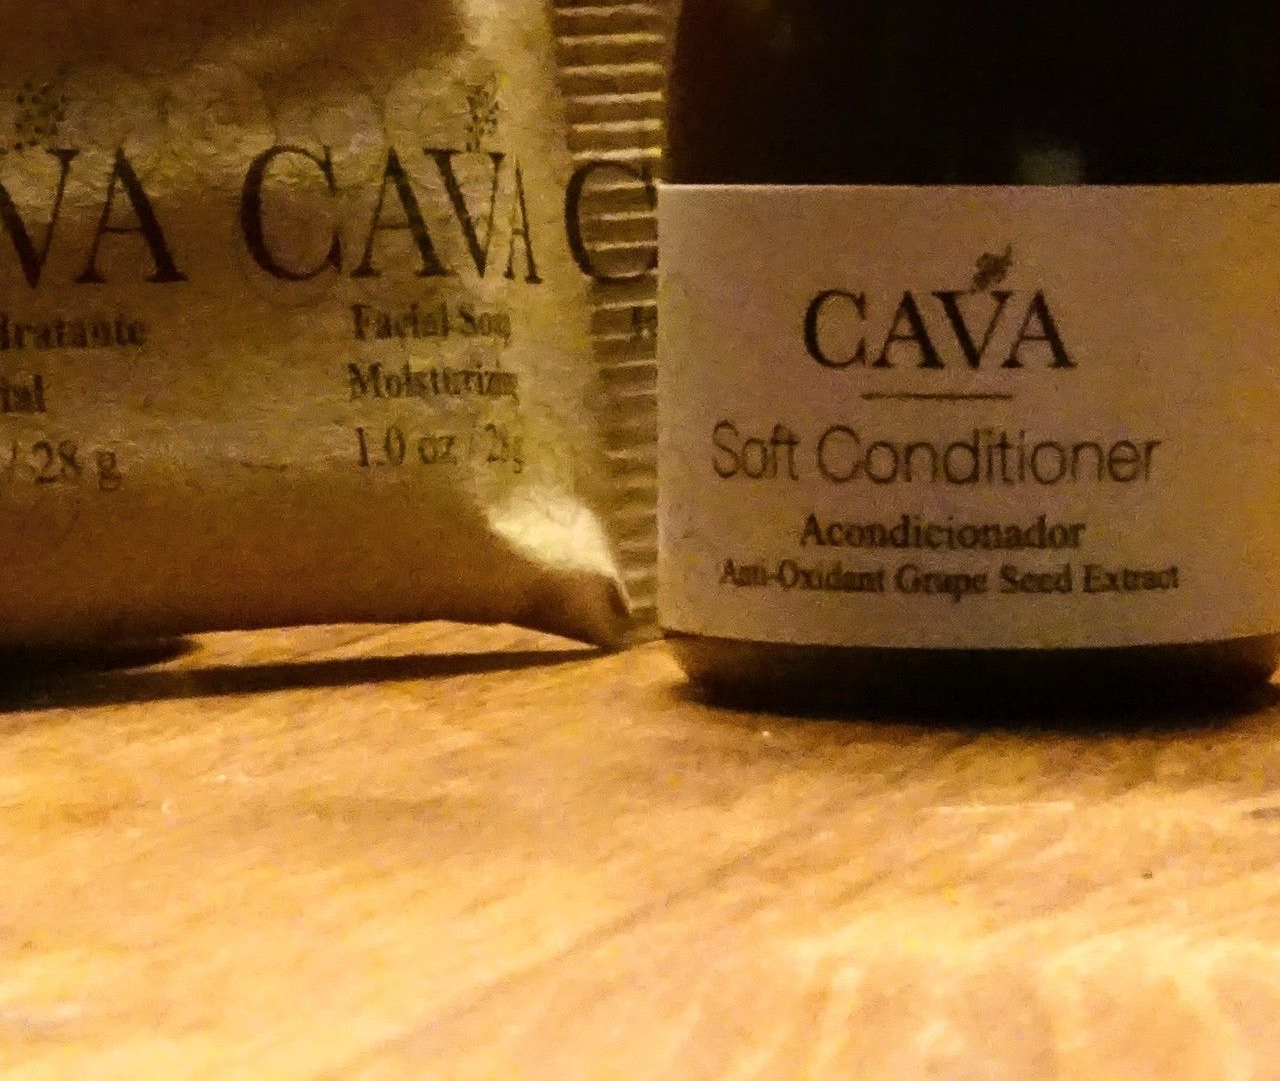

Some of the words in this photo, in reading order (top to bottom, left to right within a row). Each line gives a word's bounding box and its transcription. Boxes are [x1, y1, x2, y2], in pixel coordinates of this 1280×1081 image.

[240, 143, 543, 285] CAVA
[803, 289, 1079, 371] CAVA
[31, 439, 84, 485] 28
[97, 450, 124, 492] g
[355, 426, 407, 469] 1.0
[417, 435, 458, 465] oz
[711, 420, 802, 482] Soft
[816, 424, 1164, 485] Conditioner
[800, 513, 1087, 551] Acondicionador
[720, 557, 886, 594] Anti-Oxidant
[896, 564, 990, 603] Grape
[1000, 562, 1073, 596] Seed
[1083, 561, 1180, 592] Extract
